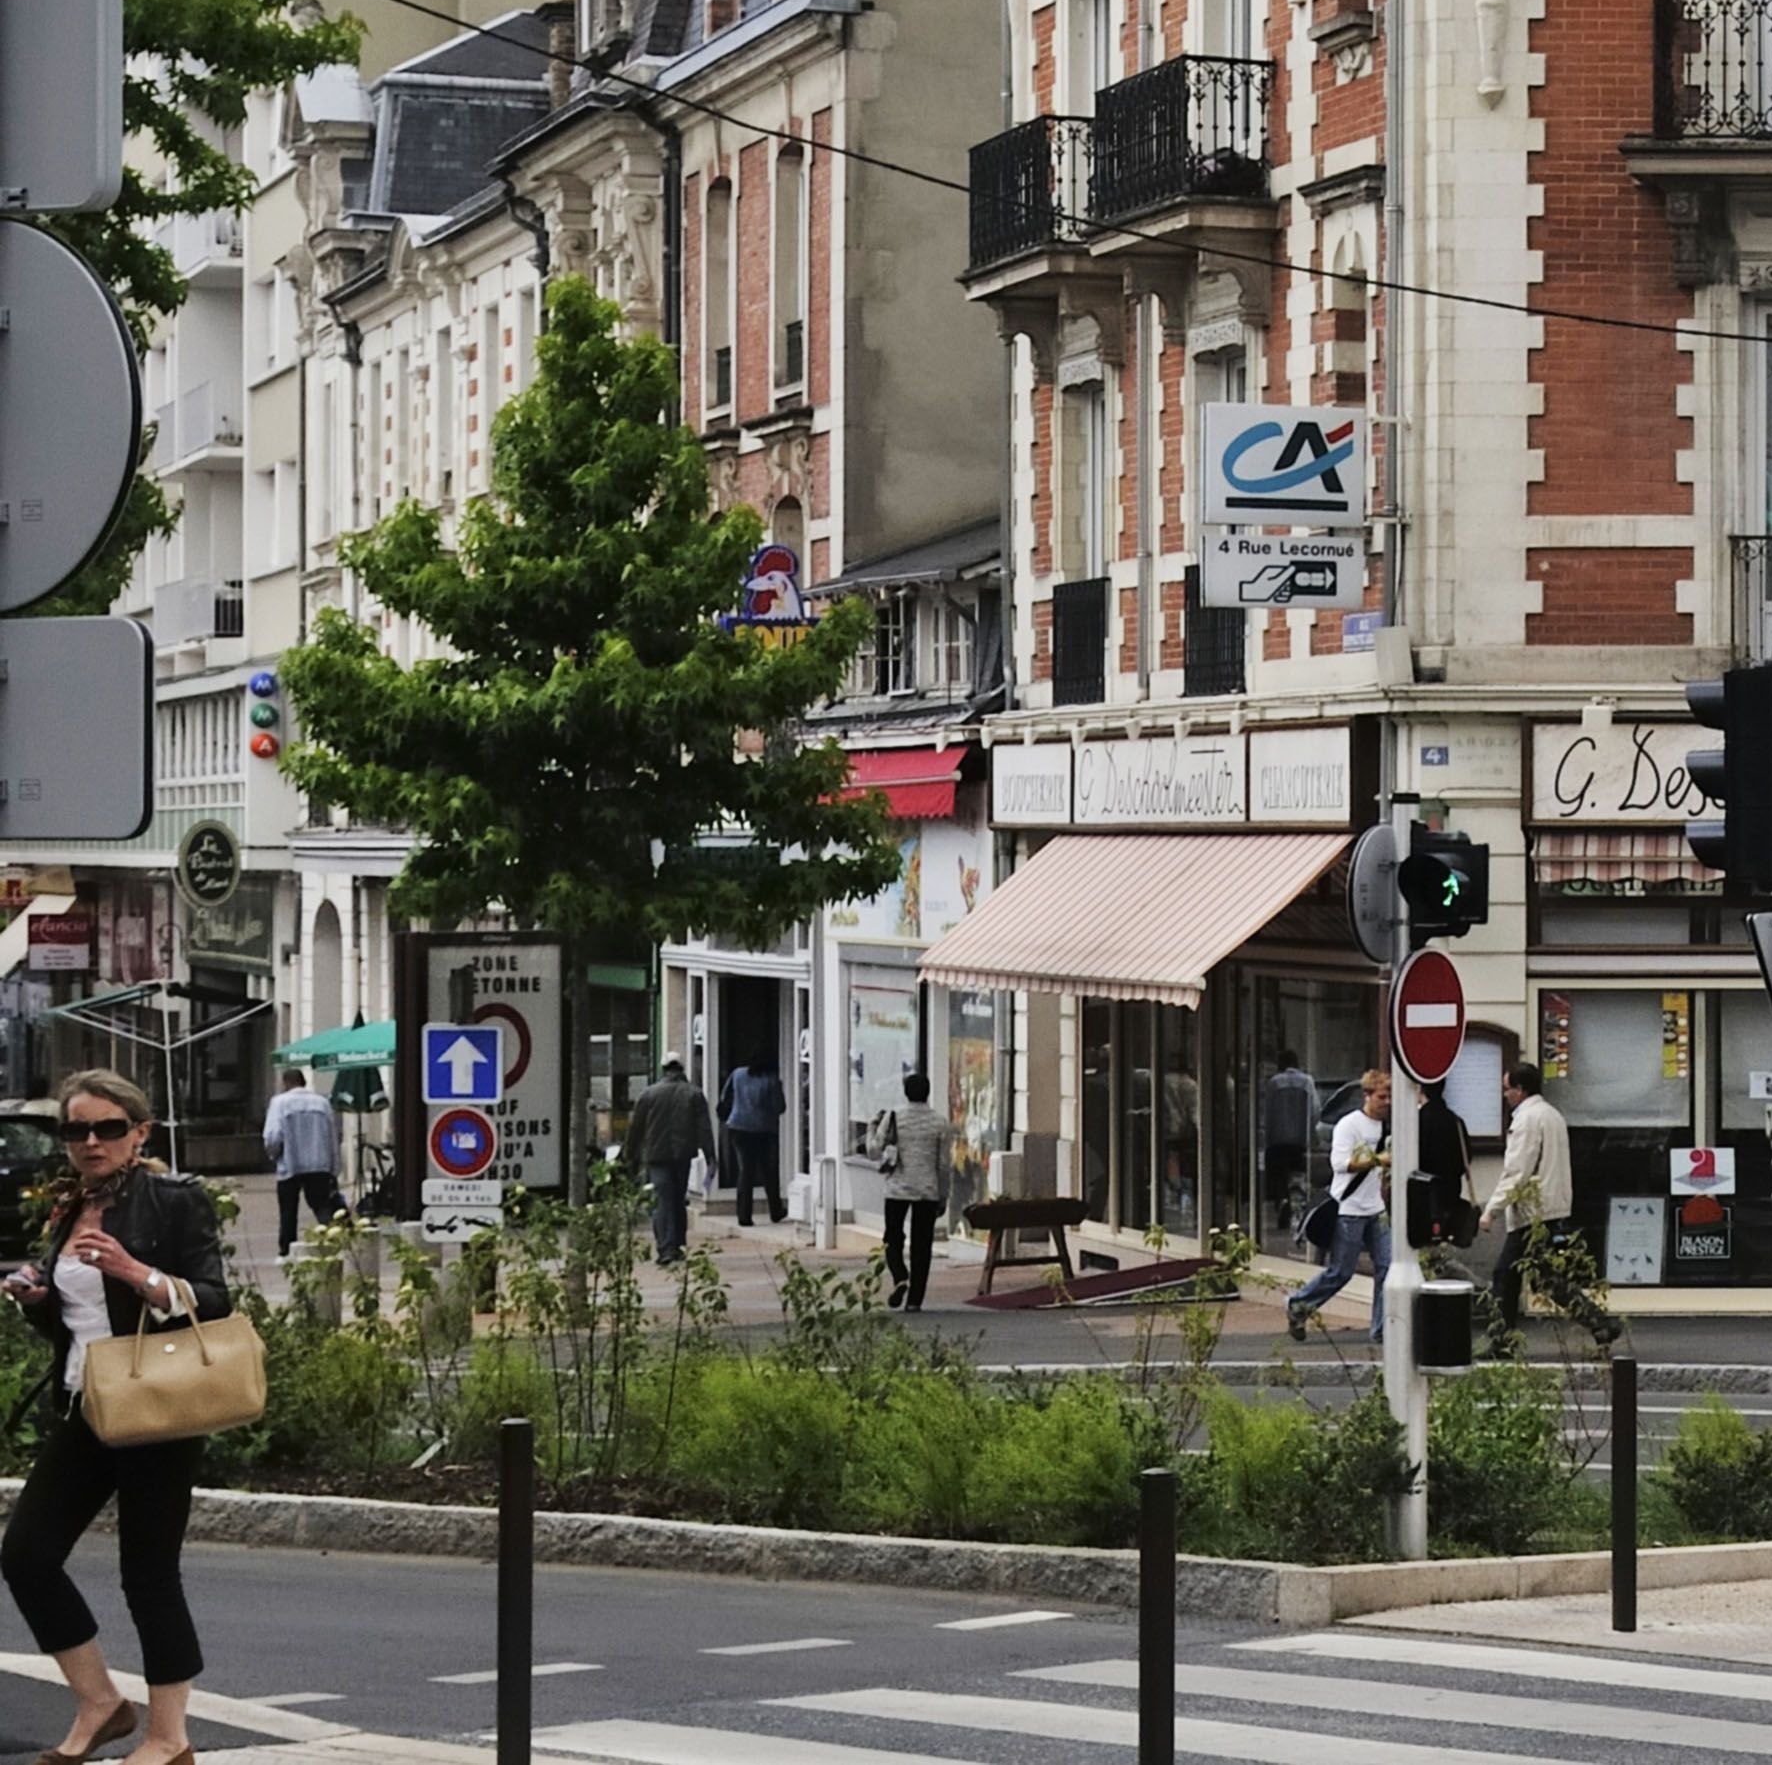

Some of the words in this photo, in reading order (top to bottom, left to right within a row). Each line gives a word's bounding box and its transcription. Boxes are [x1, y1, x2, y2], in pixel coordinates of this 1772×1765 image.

[1218, 540, 1230, 554] 4
[1238, 540, 1272, 555] Rue
[1280, 541, 1354, 557] Lecornué
[1424, 747, 1441, 764] 4
[1555, 736, 1597, 816] G.
[1001, 773, 1065, 813] BOUCHERIE
[1260, 763, 1344, 810] CHARCUTERIE
[471, 955, 519, 972] ZONE
[473, 976, 542, 994] ETONNE
[484, 1099, 519, 1117] AUF
[480, 1163, 523, 1181] H30
[1681, 1235, 1726, 1246] BLASON
[1679, 1245, 1726, 1257] PRESTIGE
